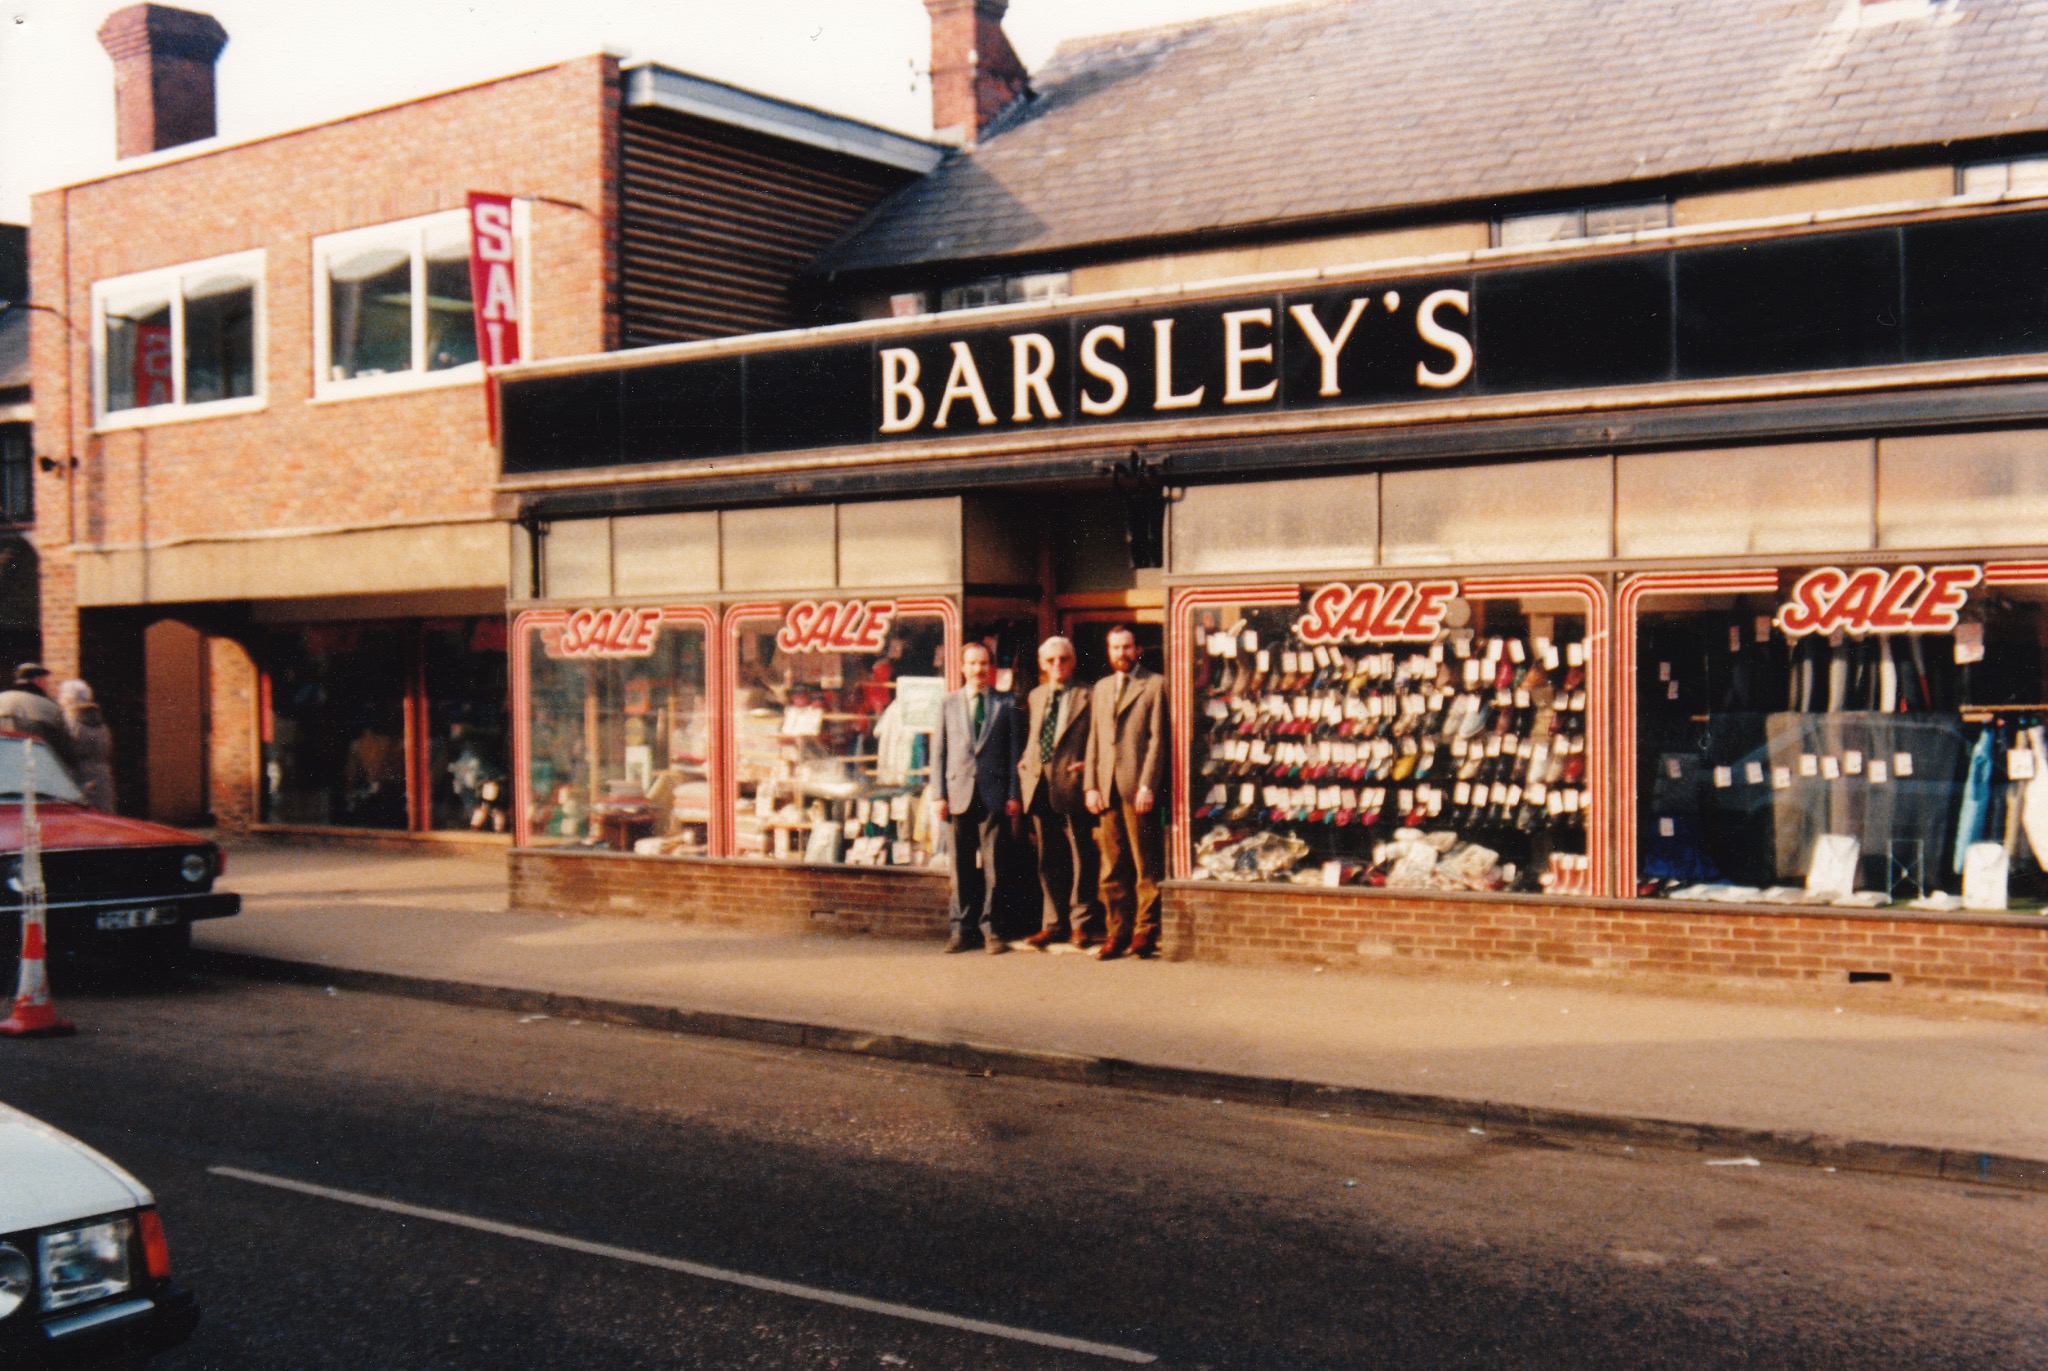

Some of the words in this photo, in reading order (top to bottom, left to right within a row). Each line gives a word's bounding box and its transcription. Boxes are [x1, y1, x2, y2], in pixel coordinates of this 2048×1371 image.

[475, 203, 518, 366] SAL
[878, 289, 1474, 435] BARSLEY'S
[562, 609, 661, 656] SALE
[777, 601, 896, 652] SALE
[1299, 581, 1458, 643] SALE
[1780, 566, 1982, 635] SALE
